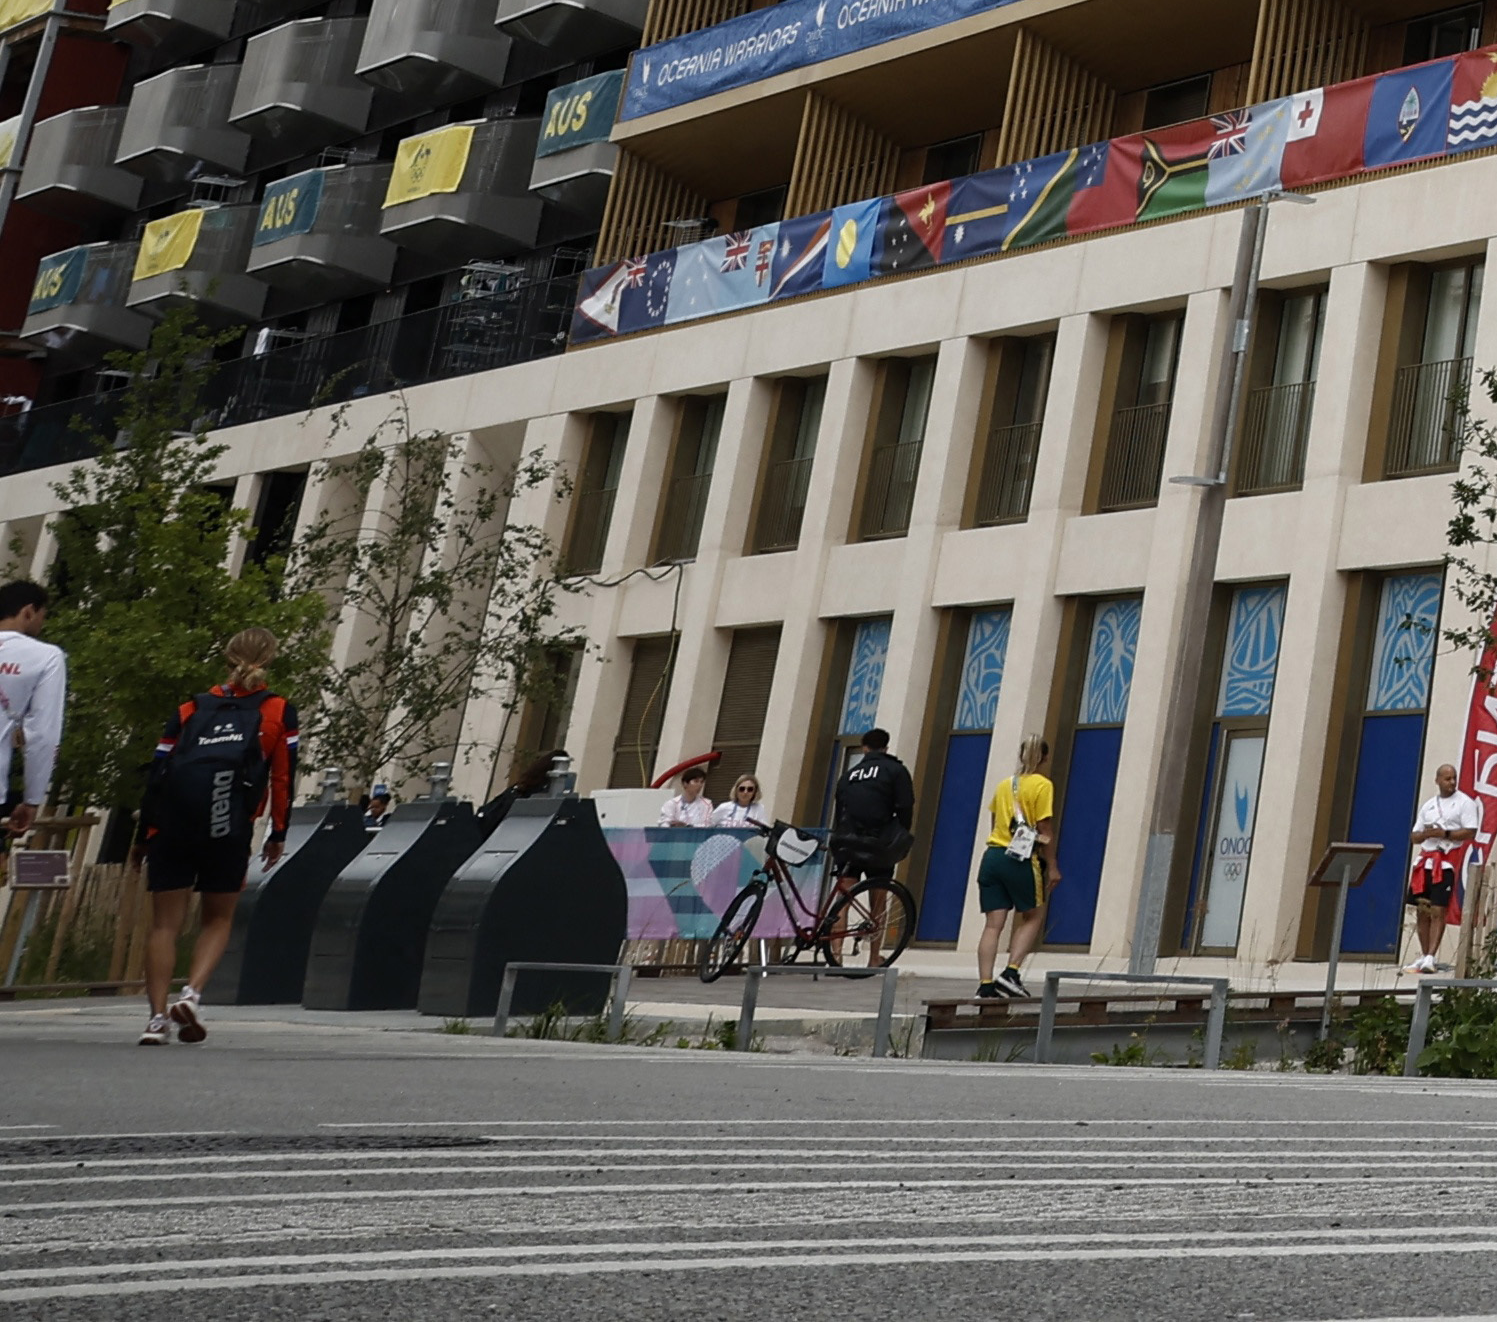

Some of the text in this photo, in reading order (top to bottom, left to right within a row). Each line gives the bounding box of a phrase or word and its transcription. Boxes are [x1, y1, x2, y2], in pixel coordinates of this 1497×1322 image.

[657, 21, 802, 86] OCEANIA WARRIORS
[543, 90, 594, 141] AUS
[260, 187, 300, 233] AUS
[198, 733, 244, 745] TeamNL
[848, 765, 880, 782] FIJI
[210, 769, 235, 838] arena
[1220, 836, 1251, 855] ONOC
